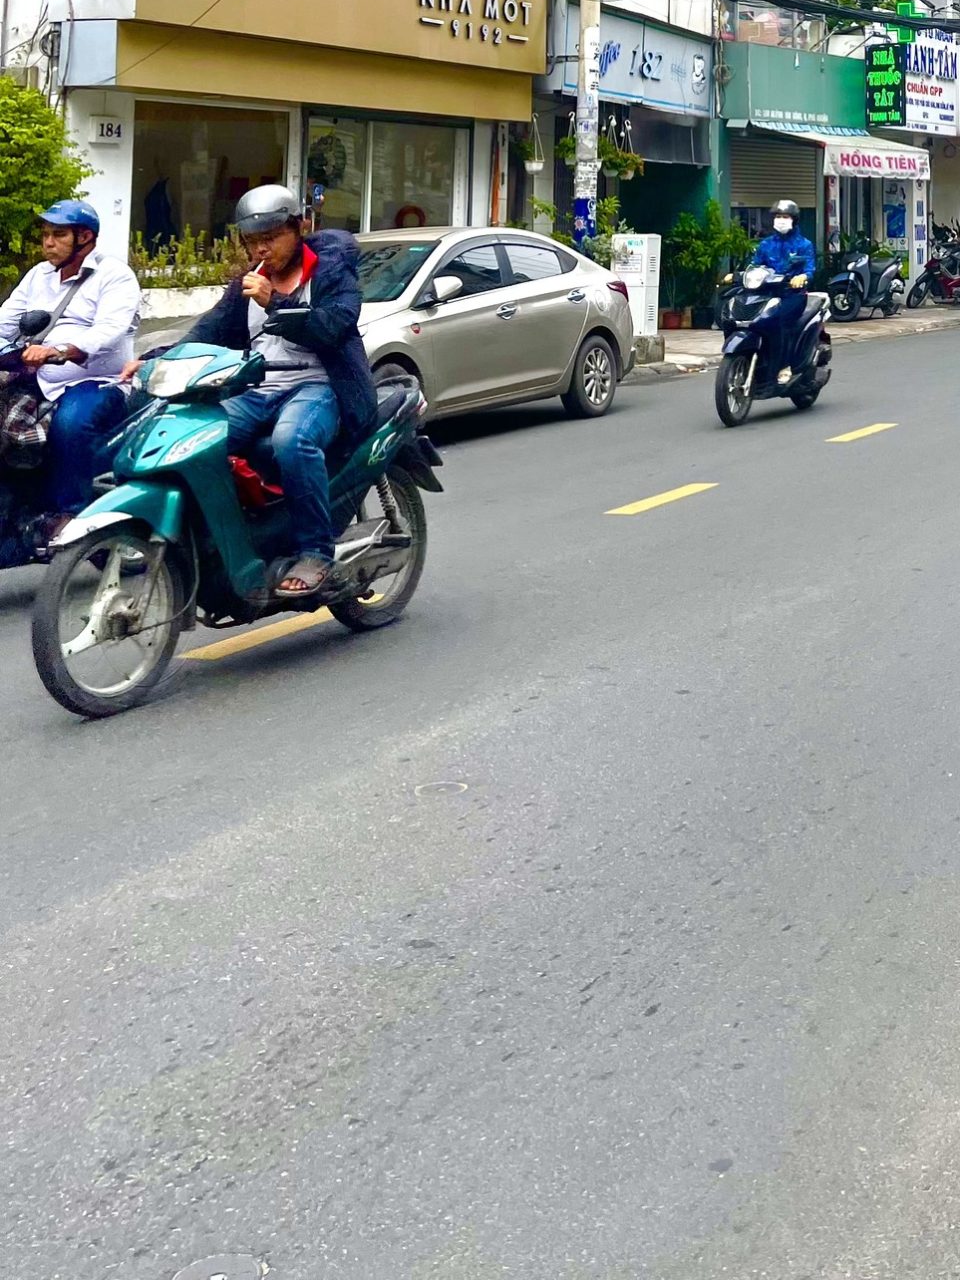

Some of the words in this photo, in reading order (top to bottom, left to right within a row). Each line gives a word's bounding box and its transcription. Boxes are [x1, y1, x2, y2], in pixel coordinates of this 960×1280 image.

[451, 19, 502, 45] 9192
[929, 84, 943, 97] GPP
[98, 122, 122, 138] 184
